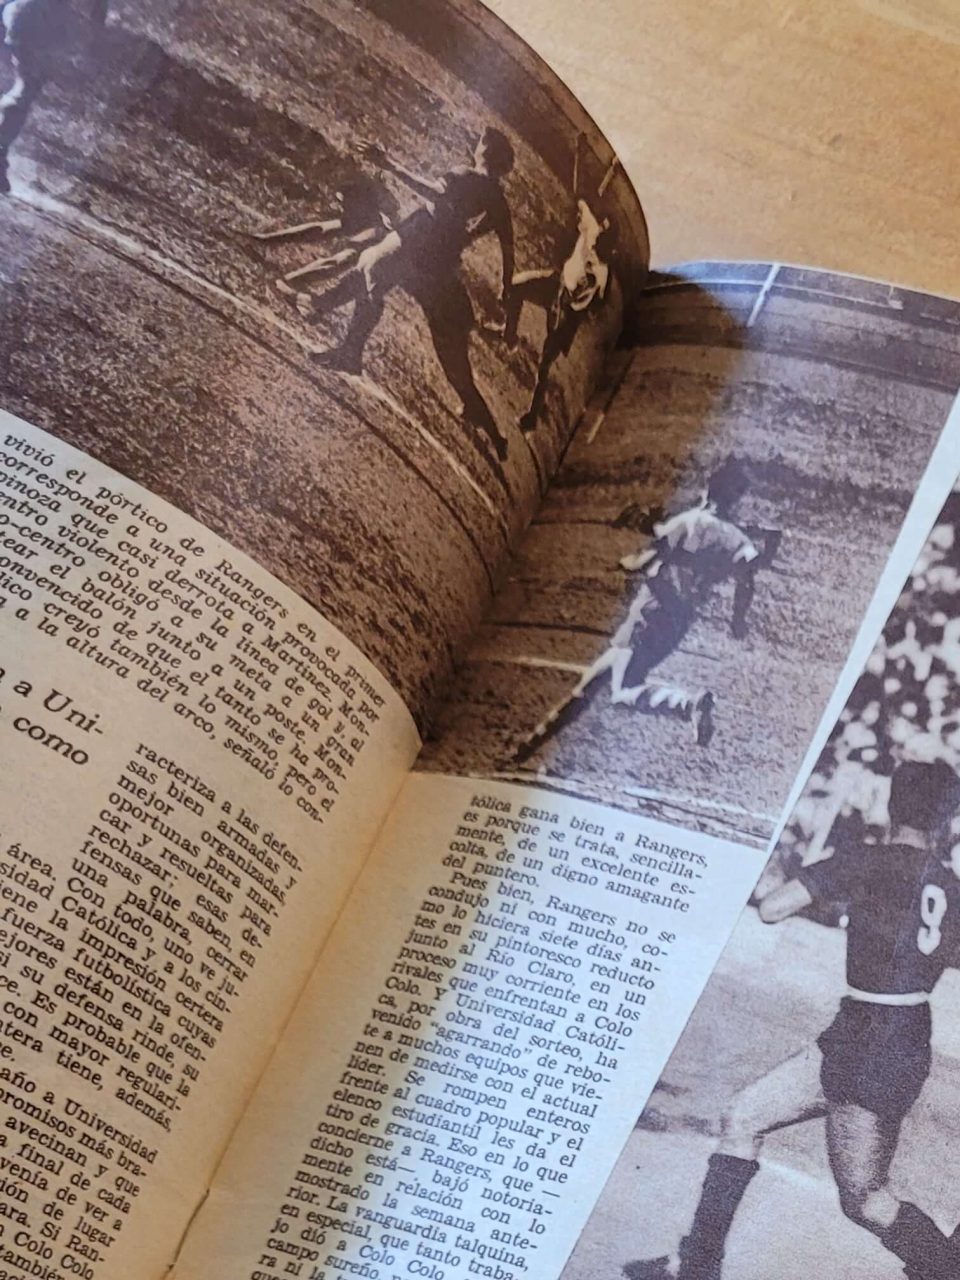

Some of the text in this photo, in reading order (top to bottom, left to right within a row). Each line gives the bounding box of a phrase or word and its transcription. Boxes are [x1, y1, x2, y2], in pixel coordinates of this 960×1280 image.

[3, 434, 386, 707] vivió el pórtico de Rangers en el primer
[125, 524, 140, 537] a
[149, 537, 187, 567] una
[194, 568, 276, 631] situación
[281, 631, 356, 700] provocada
[357, 700, 380, 722] por
[13, 680, 103, 735] a Uni-
[13, 717, 89, 765] como
[135, 742, 303, 872] racteriza a las defen-
[518, 806, 559, 824] gana
[569, 815, 605, 836] bien
[614, 831, 625, 842] a
[634, 833, 708, 868] Rangers,
[917, 884, 947, 955] 9
[5, 1115, 140, 1198] avecinan y que
[257, 1254, 277, 1268] ra
[283, 1261, 303, 1276] ni
